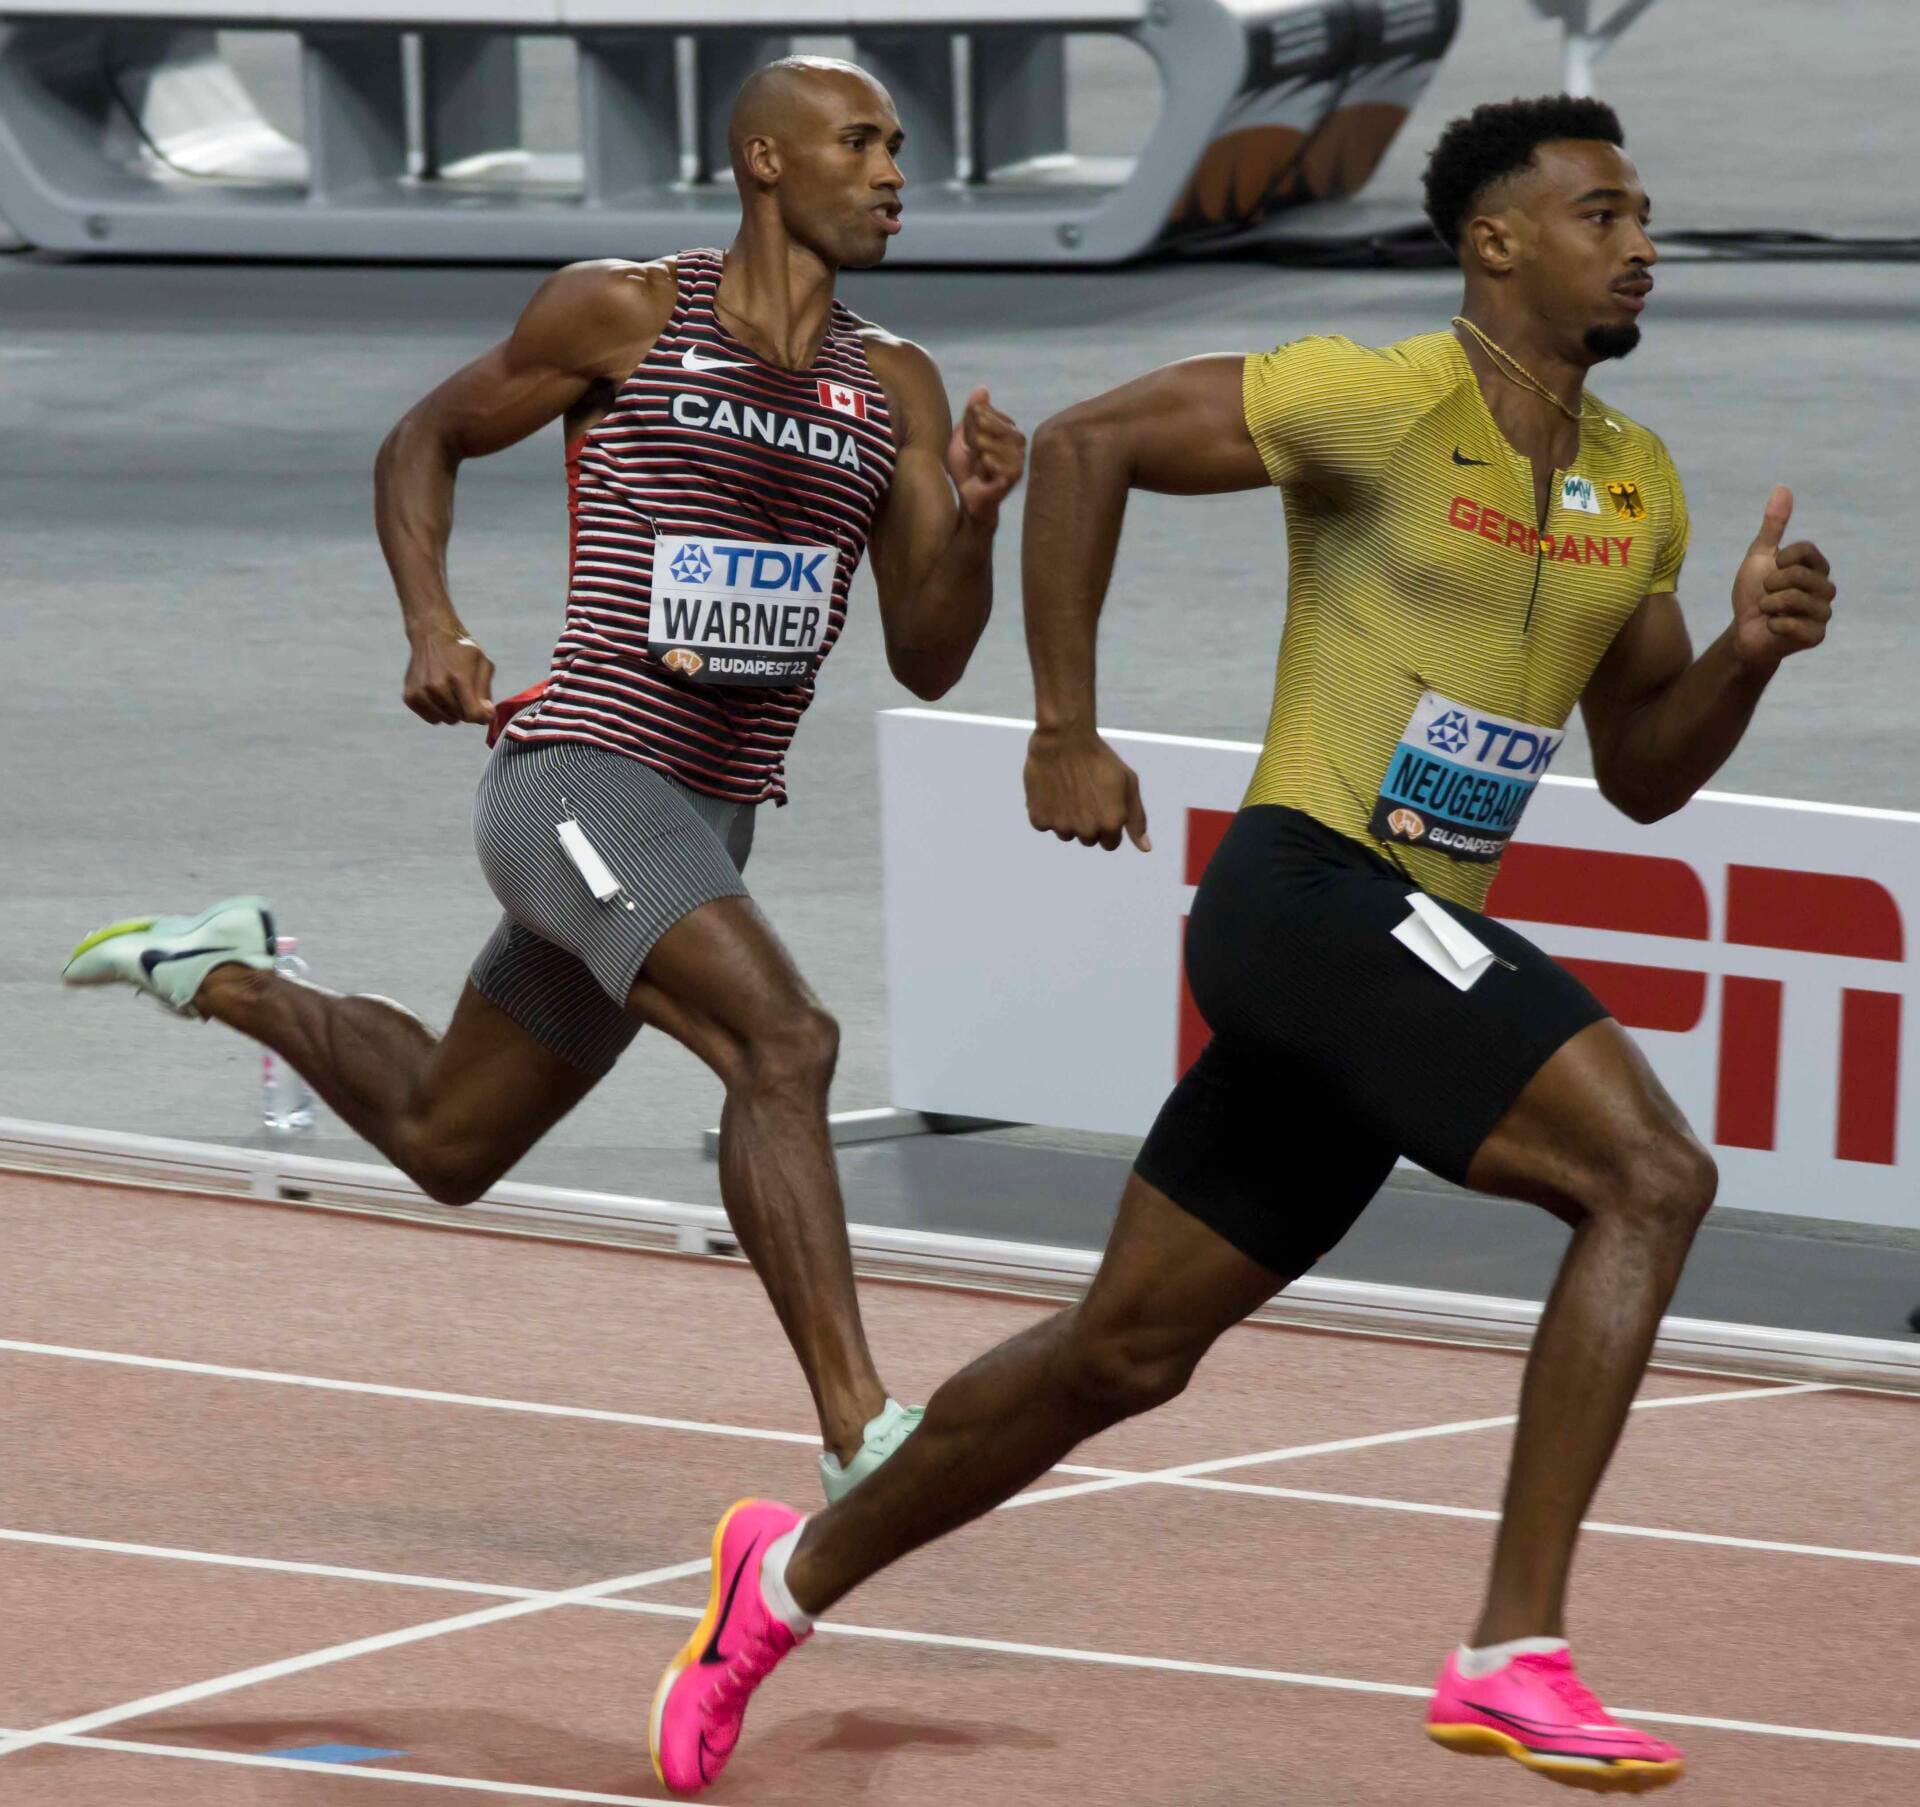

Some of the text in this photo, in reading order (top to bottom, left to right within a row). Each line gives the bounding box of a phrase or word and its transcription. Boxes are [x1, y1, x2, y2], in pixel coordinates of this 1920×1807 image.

[672, 393, 861, 472] CANADA
[1448, 495, 1633, 567] GERMANY
[712, 546, 829, 593] TDK
[662, 597, 821, 648] WARNER
[1475, 719, 1565, 774] TDK
[1391, 752, 1535, 829] NEUGEBAU
